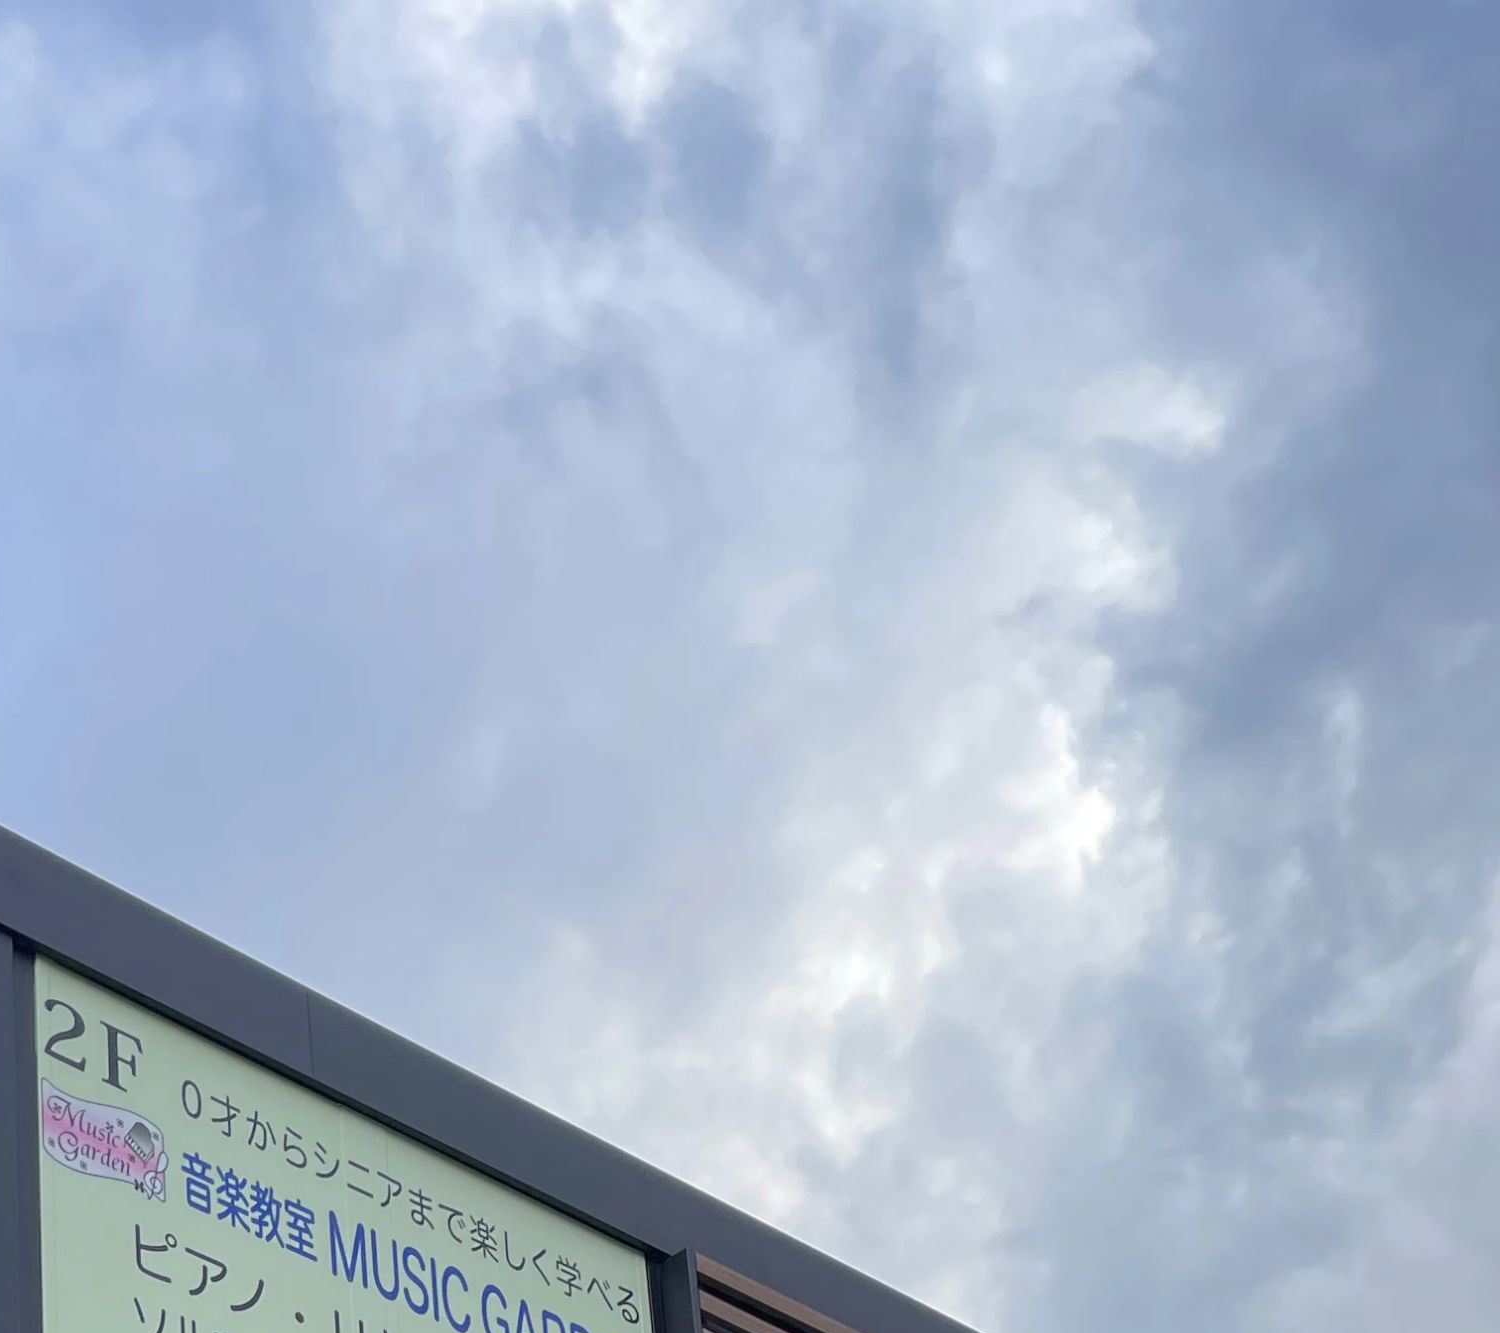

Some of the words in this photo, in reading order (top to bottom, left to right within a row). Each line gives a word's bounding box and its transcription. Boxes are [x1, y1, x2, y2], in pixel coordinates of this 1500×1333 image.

[44, 998, 143, 1093] 2F
[47, 1096, 122, 1149] Music
[57, 1131, 132, 1177] Garden
[180, 1151, 318, 1263] 音楽教室
[328, 1210, 472, 1333] MUSIC
[181, 1079, 640, 1325] 0才からシニアまで楽しく学べる
